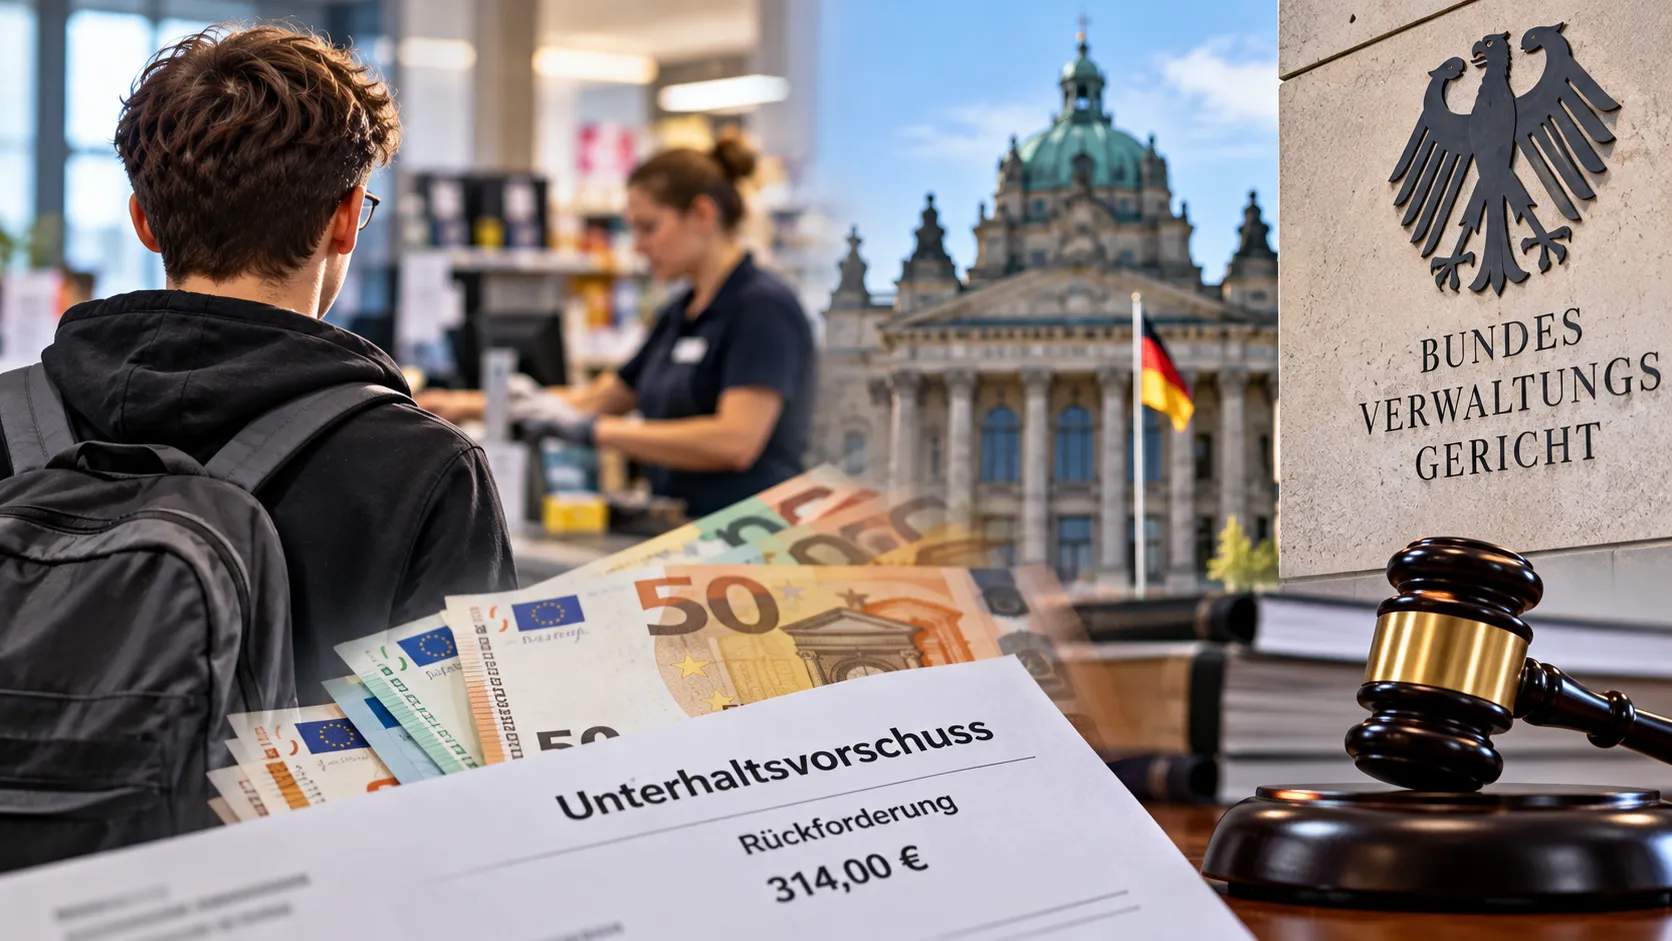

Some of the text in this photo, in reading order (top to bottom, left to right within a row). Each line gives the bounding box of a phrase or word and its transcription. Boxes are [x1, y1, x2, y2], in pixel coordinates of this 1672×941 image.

[1420, 307, 1584, 374] BUNDES
[1358, 351, 1662, 436] VERWALTUNGS
[1415, 421, 1601, 481] GERICHT
[634, 575, 780, 637] 50
[555, 720, 995, 822] Unterhaltsvorschuss
[738, 792, 960, 856] Rückforderung
[767, 845, 930, 903] 314,00 €
